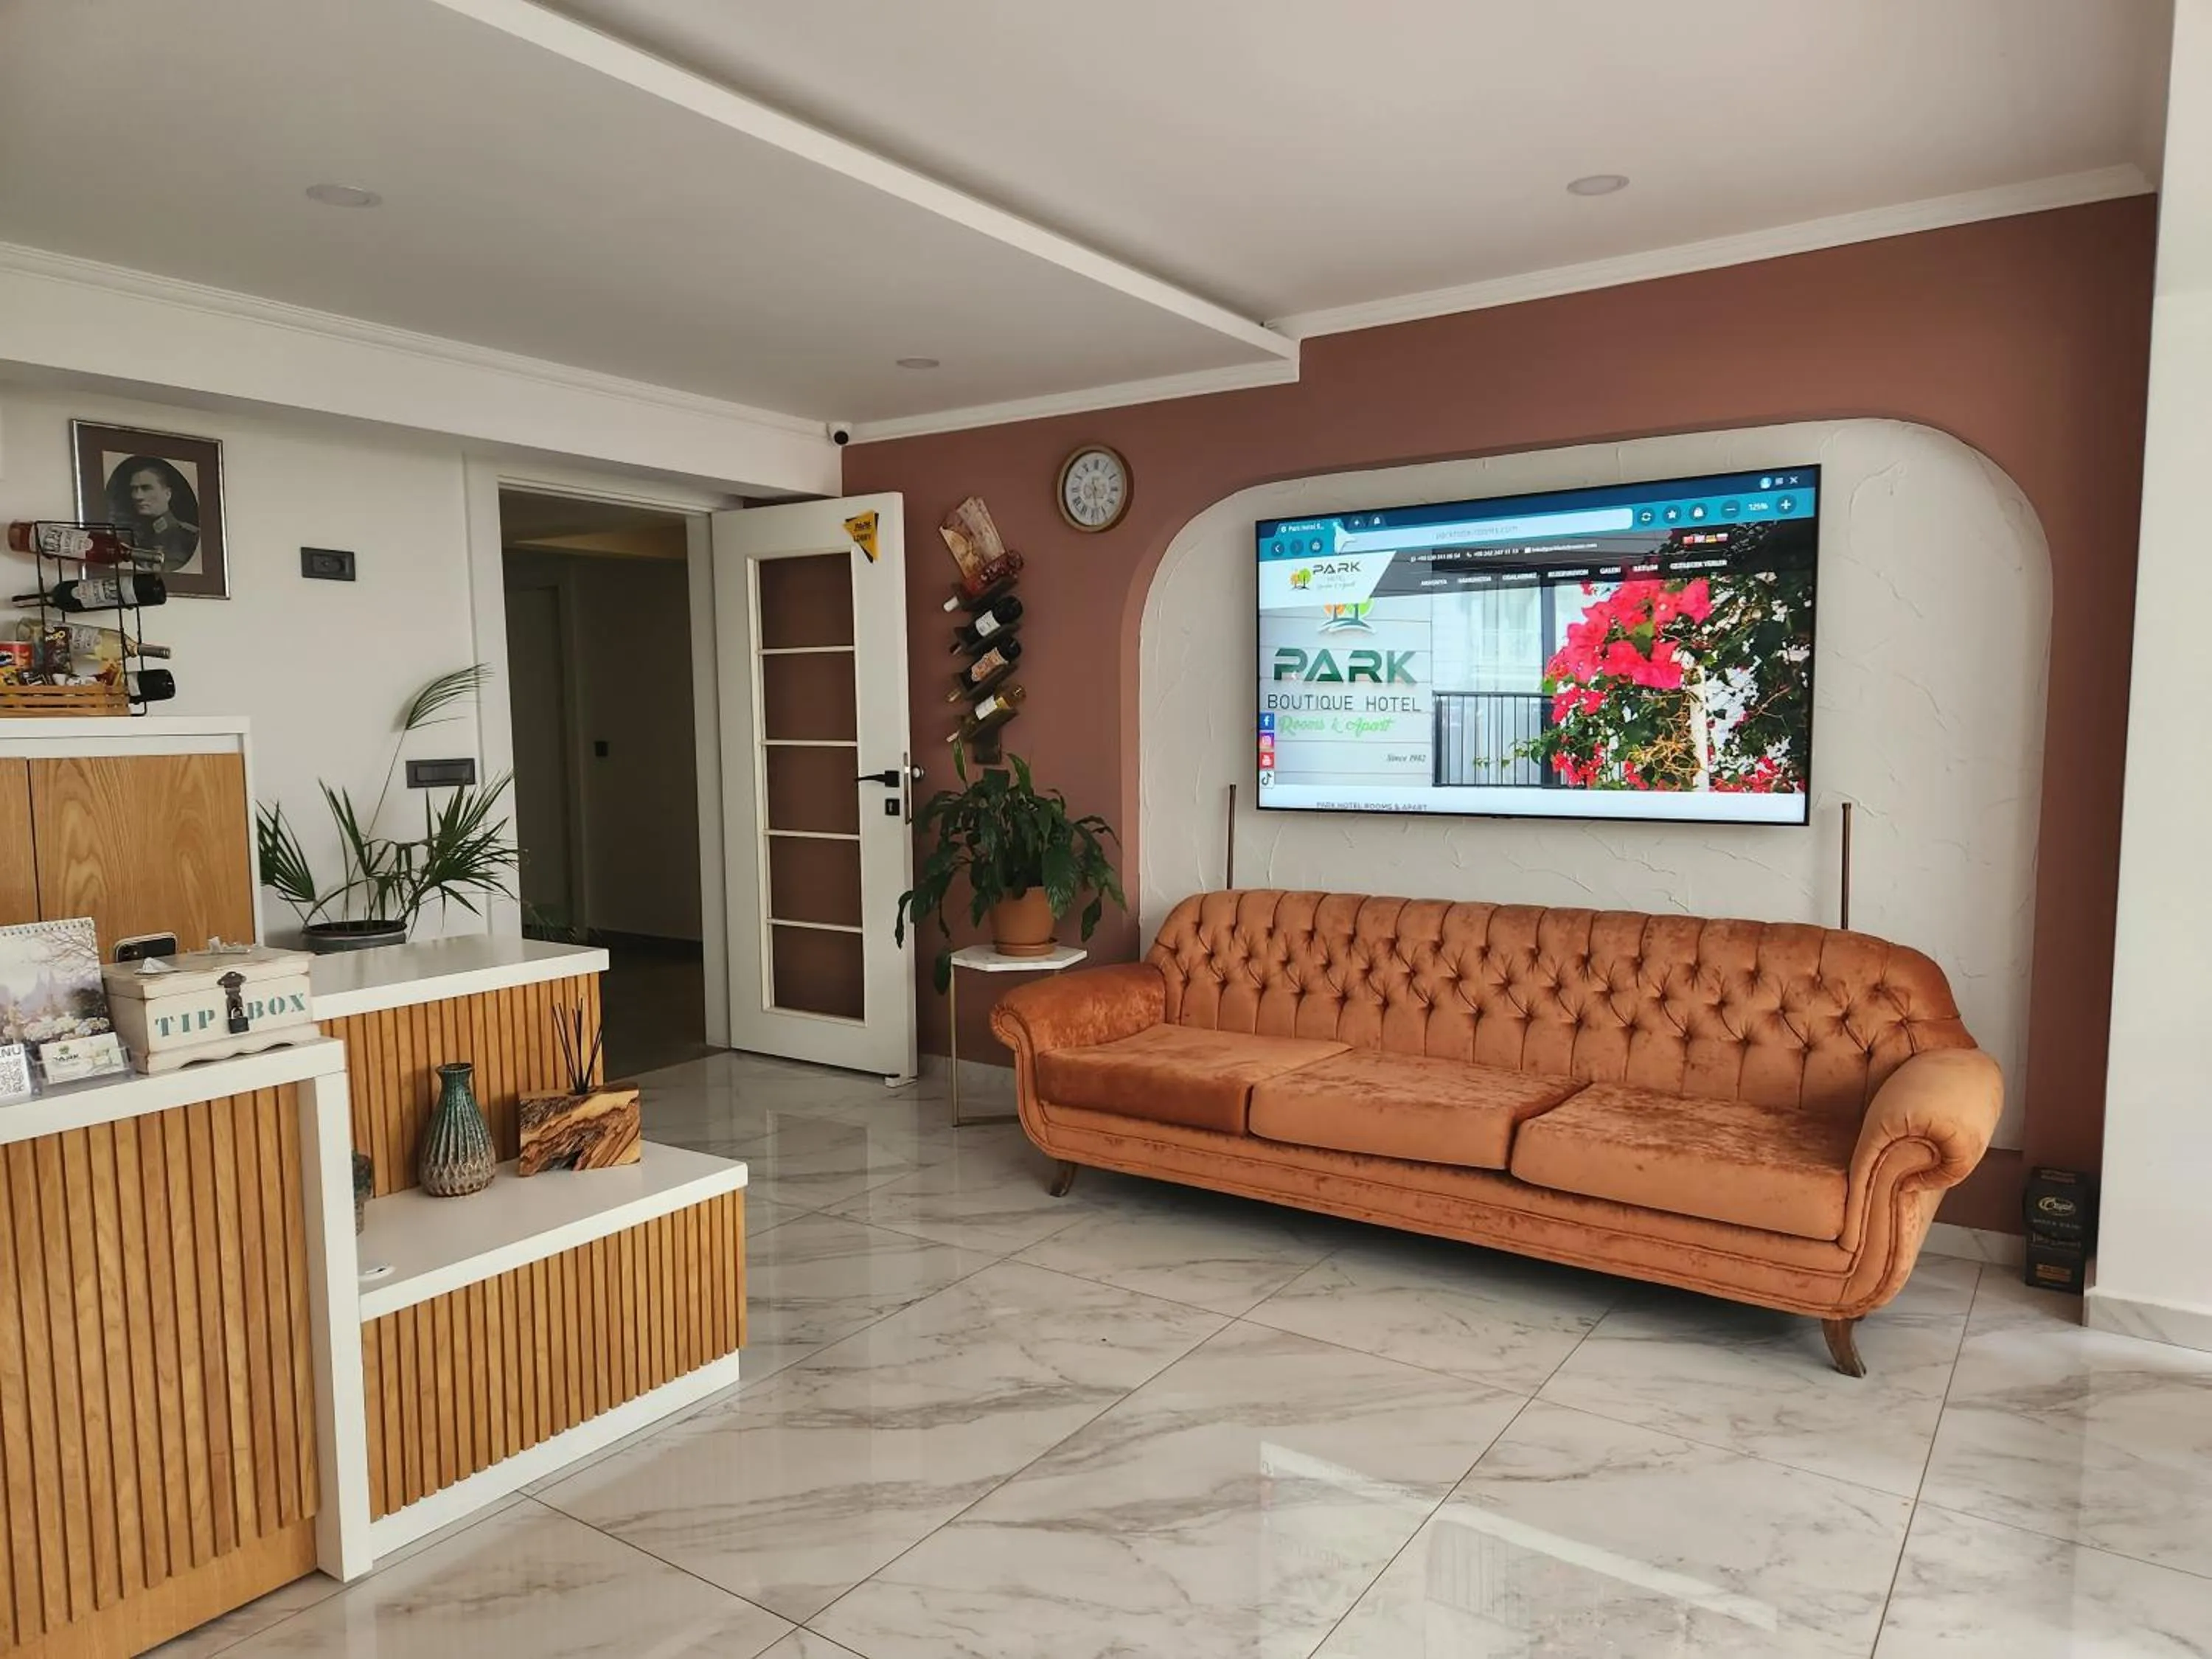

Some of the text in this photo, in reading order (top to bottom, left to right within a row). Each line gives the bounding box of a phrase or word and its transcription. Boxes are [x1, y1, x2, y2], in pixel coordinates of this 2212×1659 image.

[1312, 561, 1362, 574] PARK
[1273, 648, 1418, 684] PARK
[1267, 693, 1422, 712] BOUTIQUE HOTEL
[1278, 715, 1326, 736] Rooms
[1345, 715, 1394, 737] Apart
[1386, 754, 1408, 762] Since
[155, 993, 306, 1037] TIP BOX
